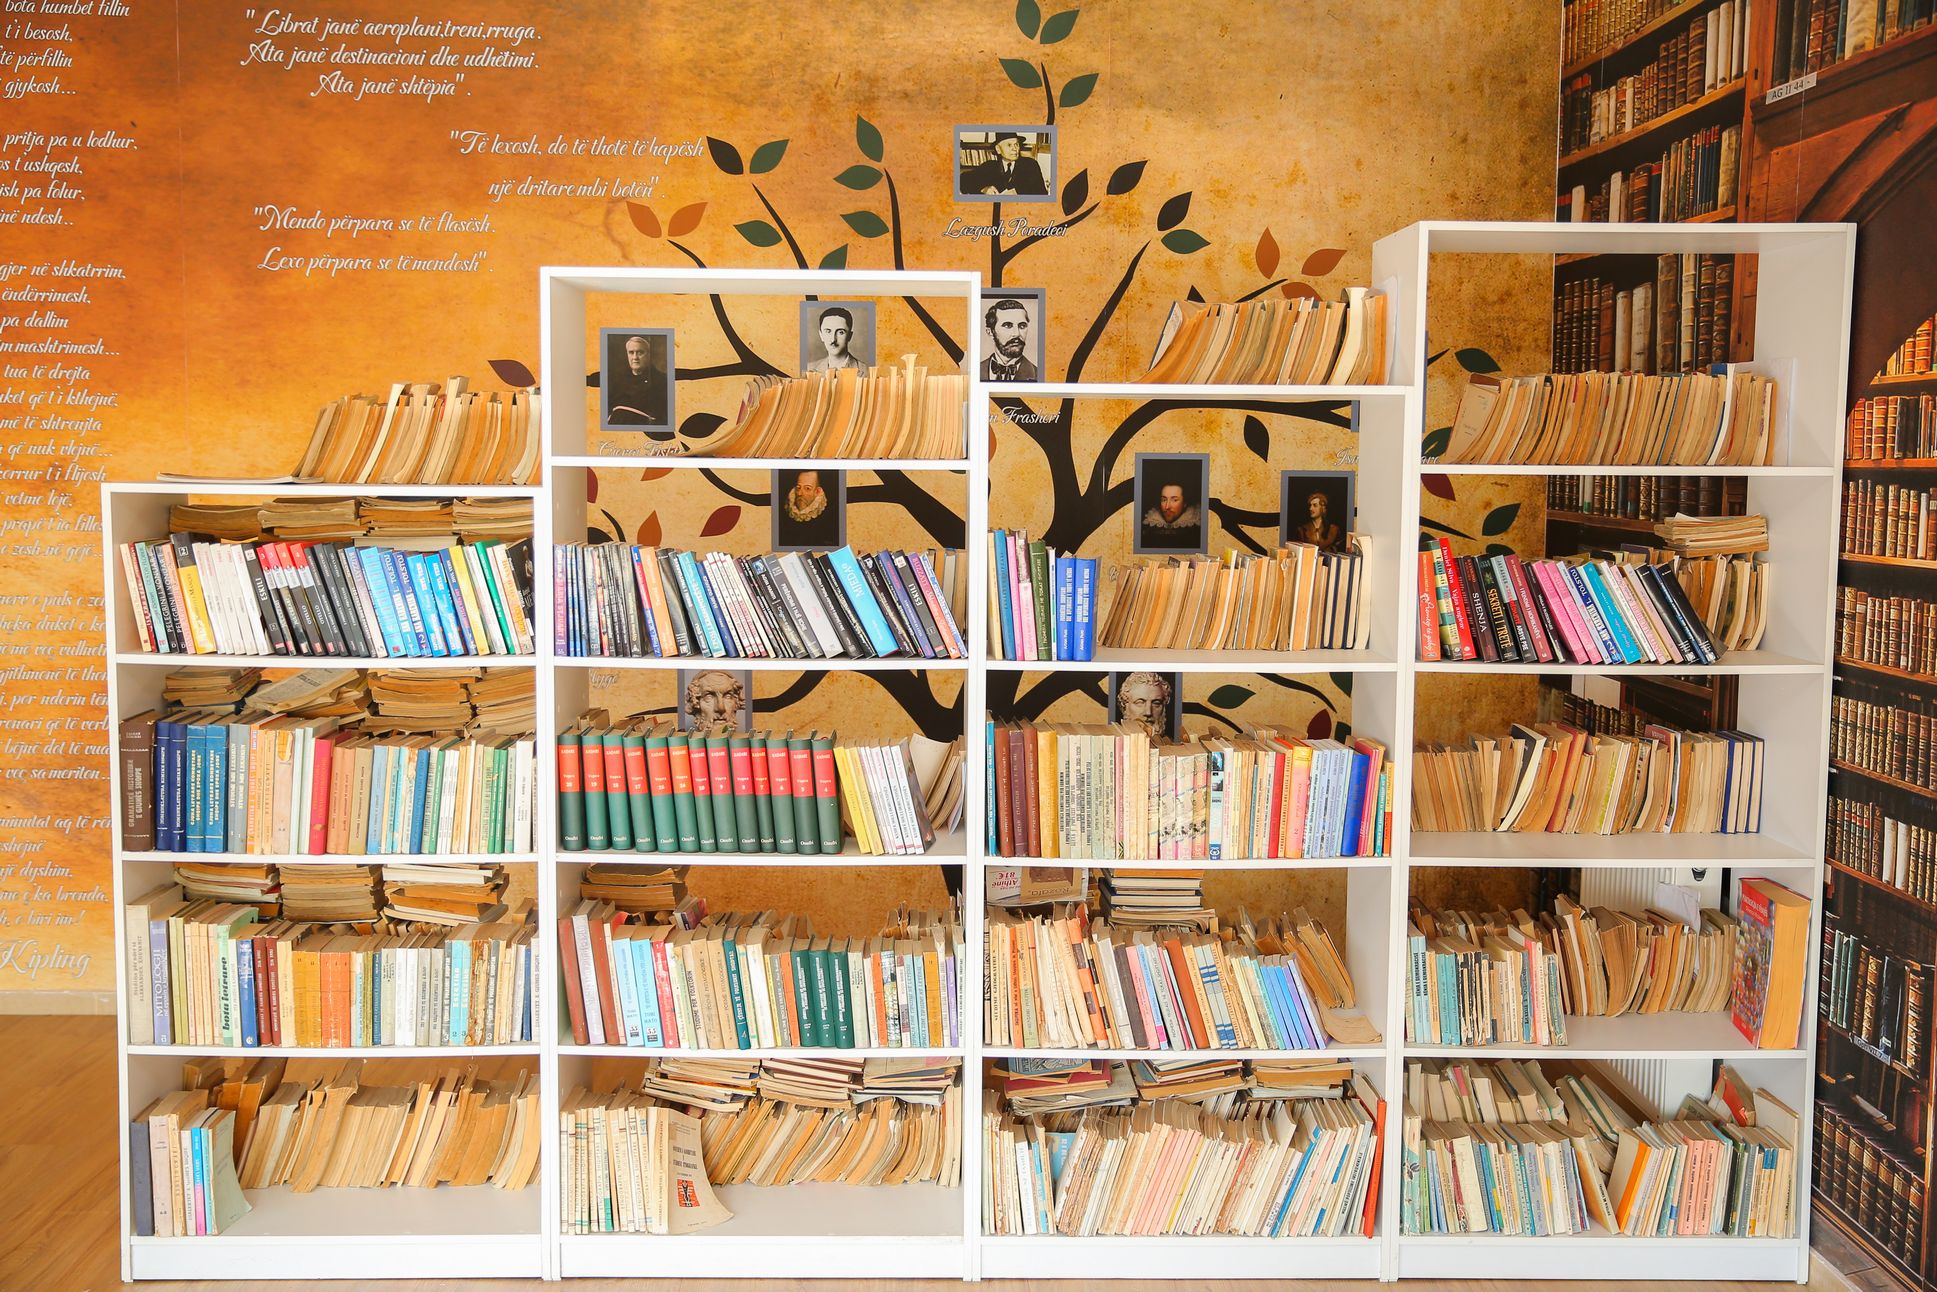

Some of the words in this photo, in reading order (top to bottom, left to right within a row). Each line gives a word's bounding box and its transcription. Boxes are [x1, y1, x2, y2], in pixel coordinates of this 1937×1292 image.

[5, 0, 36, 12] bota
[40, 0, 93, 15] humbet
[24, 22, 73, 42] besosh,
[318, 18, 362, 41] janë
[15, 47, 73, 73] përfillin
[240, 39, 284, 66] Ata
[284, 47, 328, 70] janë
[330, 44, 427, 67] destinacioni
[429, 46, 459, 66] dhe
[310, 70, 354, 96] Ata
[354, 78, 398, 101] janë
[1771, 89, 1783, 100] AG
[1793, 80, 1804, 92] 44
[4, 131, 45, 152] pritja
[47, 135, 68, 153] pa
[72, 135, 83, 148] u
[490, 134, 542, 156] lexosh,
[547, 135, 568, 155] do
[572, 138, 589, 156] të
[590, 136, 632, 156] thotë
[632, 138, 649, 156] të
[649, 136, 704, 165] hapësh
[21, 186, 42, 204] pa
[47, 179, 86, 201] folur,
[488, 180, 516, 202] një
[517, 176, 575, 196] dritare
[576, 178, 608, 197] mbi
[327, 214, 393, 238] përpara
[398, 219, 415, 231] se
[418, 217, 435, 232] të
[31, 262, 51, 276] në
[257, 246, 305, 271] Lexo
[306, 253, 372, 277] përpara
[377, 259, 392, 270] se
[397, 256, 411, 271] të
[24, 310, 69, 328] dallim
[3, 364, 29, 378] tua
[31, 365, 49, 379] të
[48, 362, 92, 386] drejta
[29, 391, 48, 410] që
[24, 415, 40, 430] të
[40, 413, 103, 436] shtrenjta
[27, 439, 56, 456] nuk
[1442, 546, 1452, 564] Daniel
[383, 553, 397, 583] TOLSTOJ
[396, 553, 410, 584] TOLSTOJ
[1446, 564, 1455, 584] Silva
[255, 577, 268, 601] ESKILI
[1569, 567, 1589, 597] TOLSTOJ
[908, 582, 922, 607] ESKILI
[1452, 588, 1461, 607] Vajza
[1472, 592, 1488, 633] SHENJA
[1487, 588, 1504, 620] SEKRETI
[1496, 624, 1514, 649] TRETË
[0, 939, 92, 979] Kipling
